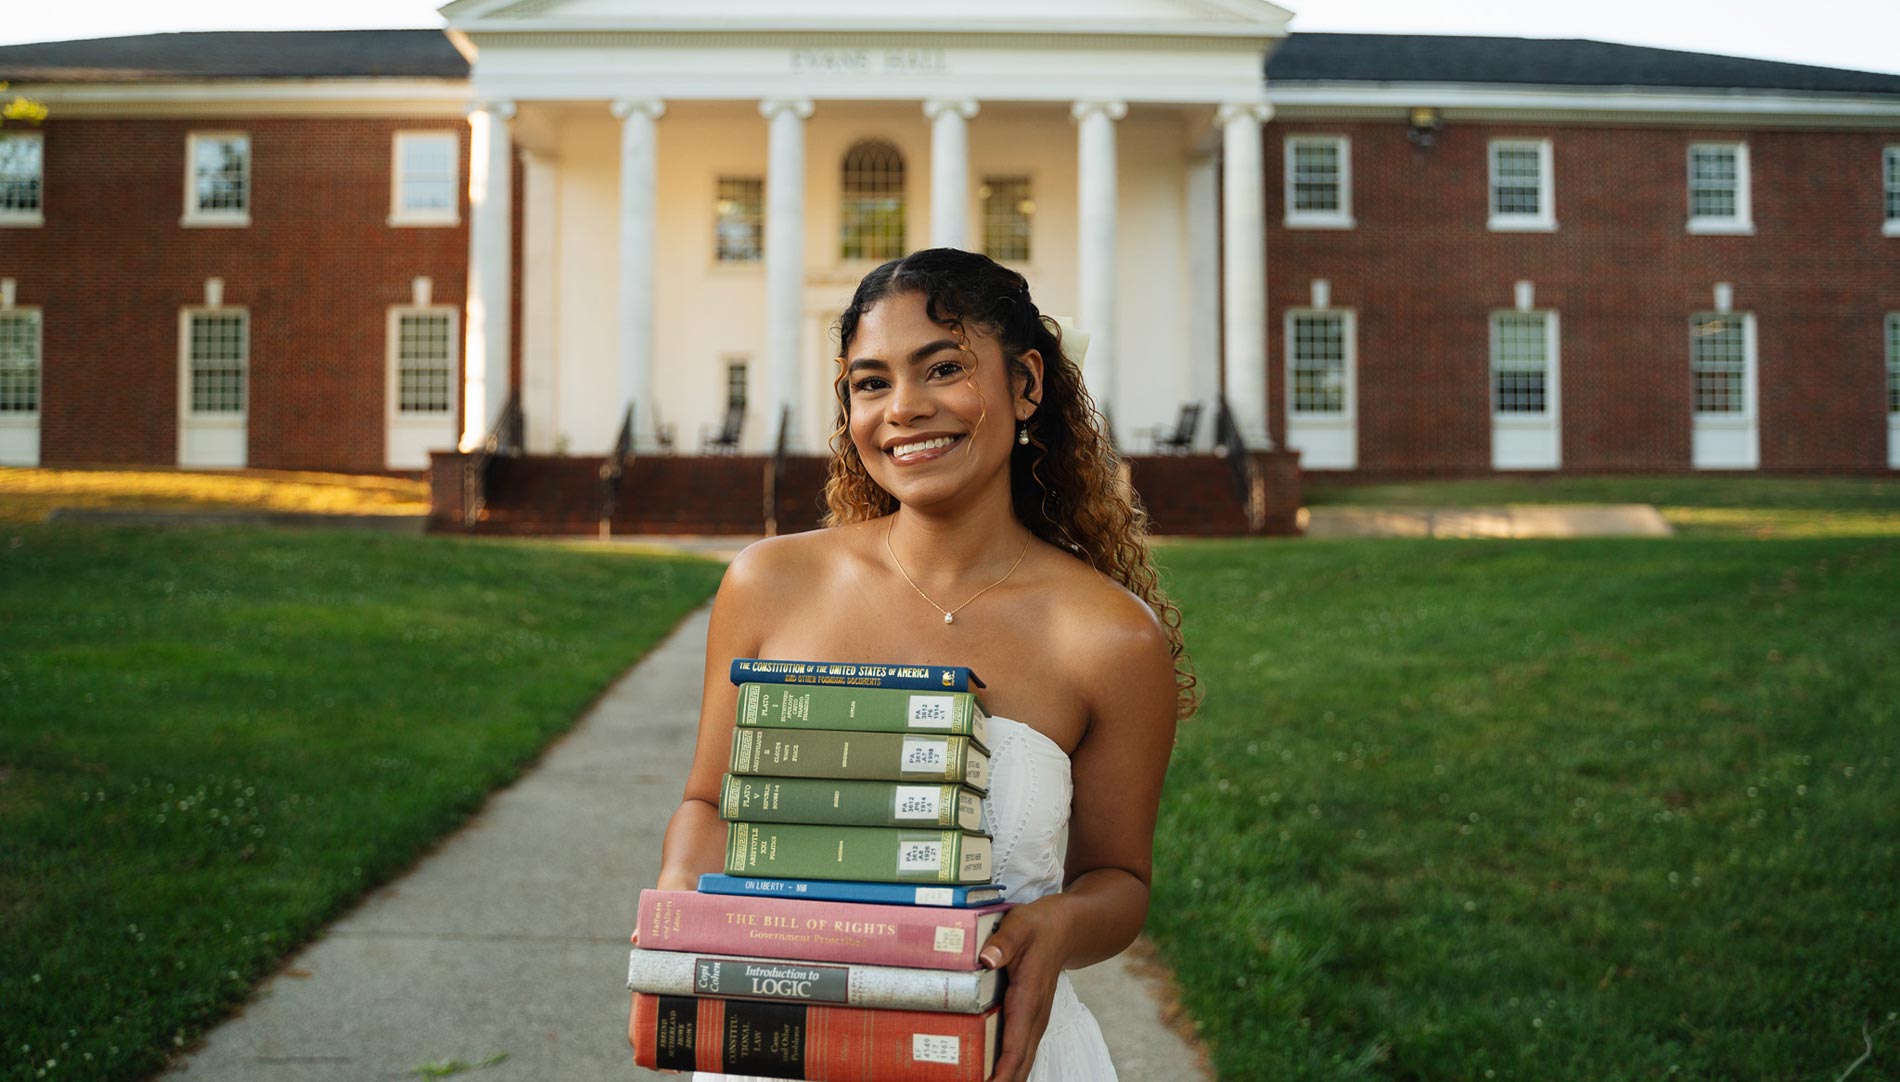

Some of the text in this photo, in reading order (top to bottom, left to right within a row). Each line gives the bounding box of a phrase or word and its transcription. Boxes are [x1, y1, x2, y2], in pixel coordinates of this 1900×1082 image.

[790, 49, 952, 73] EVANS HALL
[740, 662, 930, 679] THE CONSTITUTION OF THE UNITED STATES OF AMERICA
[784, 675, 797, 683] AND
[847, 677, 882, 686] DOCUMENTS
[761, 694, 770, 716] PLATO
[915, 710, 921, 720] PA
[753, 731, 763, 772] ARISTOPHANES
[909, 753, 915, 764] PA
[743, 784, 752, 808] PLATO
[763, 784, 771, 810] REPUBLIC
[902, 802, 908, 813] PA
[750, 828, 759, 867] ARISTOTLE
[769, 836, 777, 861] POLITICS
[906, 852, 911, 862] PA
[745, 881, 755, 890] ON
[756, 882, 784, 891] LIBERTY
[725, 913, 896, 935] THE BILL OF RIGHTS
[750, 930, 810, 943] Government
[698, 965, 710, 989] Copi
[710, 962, 722, 993] Cohen
[745, 966, 820, 981] Introduction to
[752, 978, 812, 998] LOGIC
[741, 1022, 750, 1059] TIONAL
[753, 1030, 762, 1052] LAW
[770, 1032, 779, 1053] Cases
[782, 1024, 790, 1046] Other
[792, 1026, 800, 1061] Problems
[915, 1048, 922, 1058] KF
